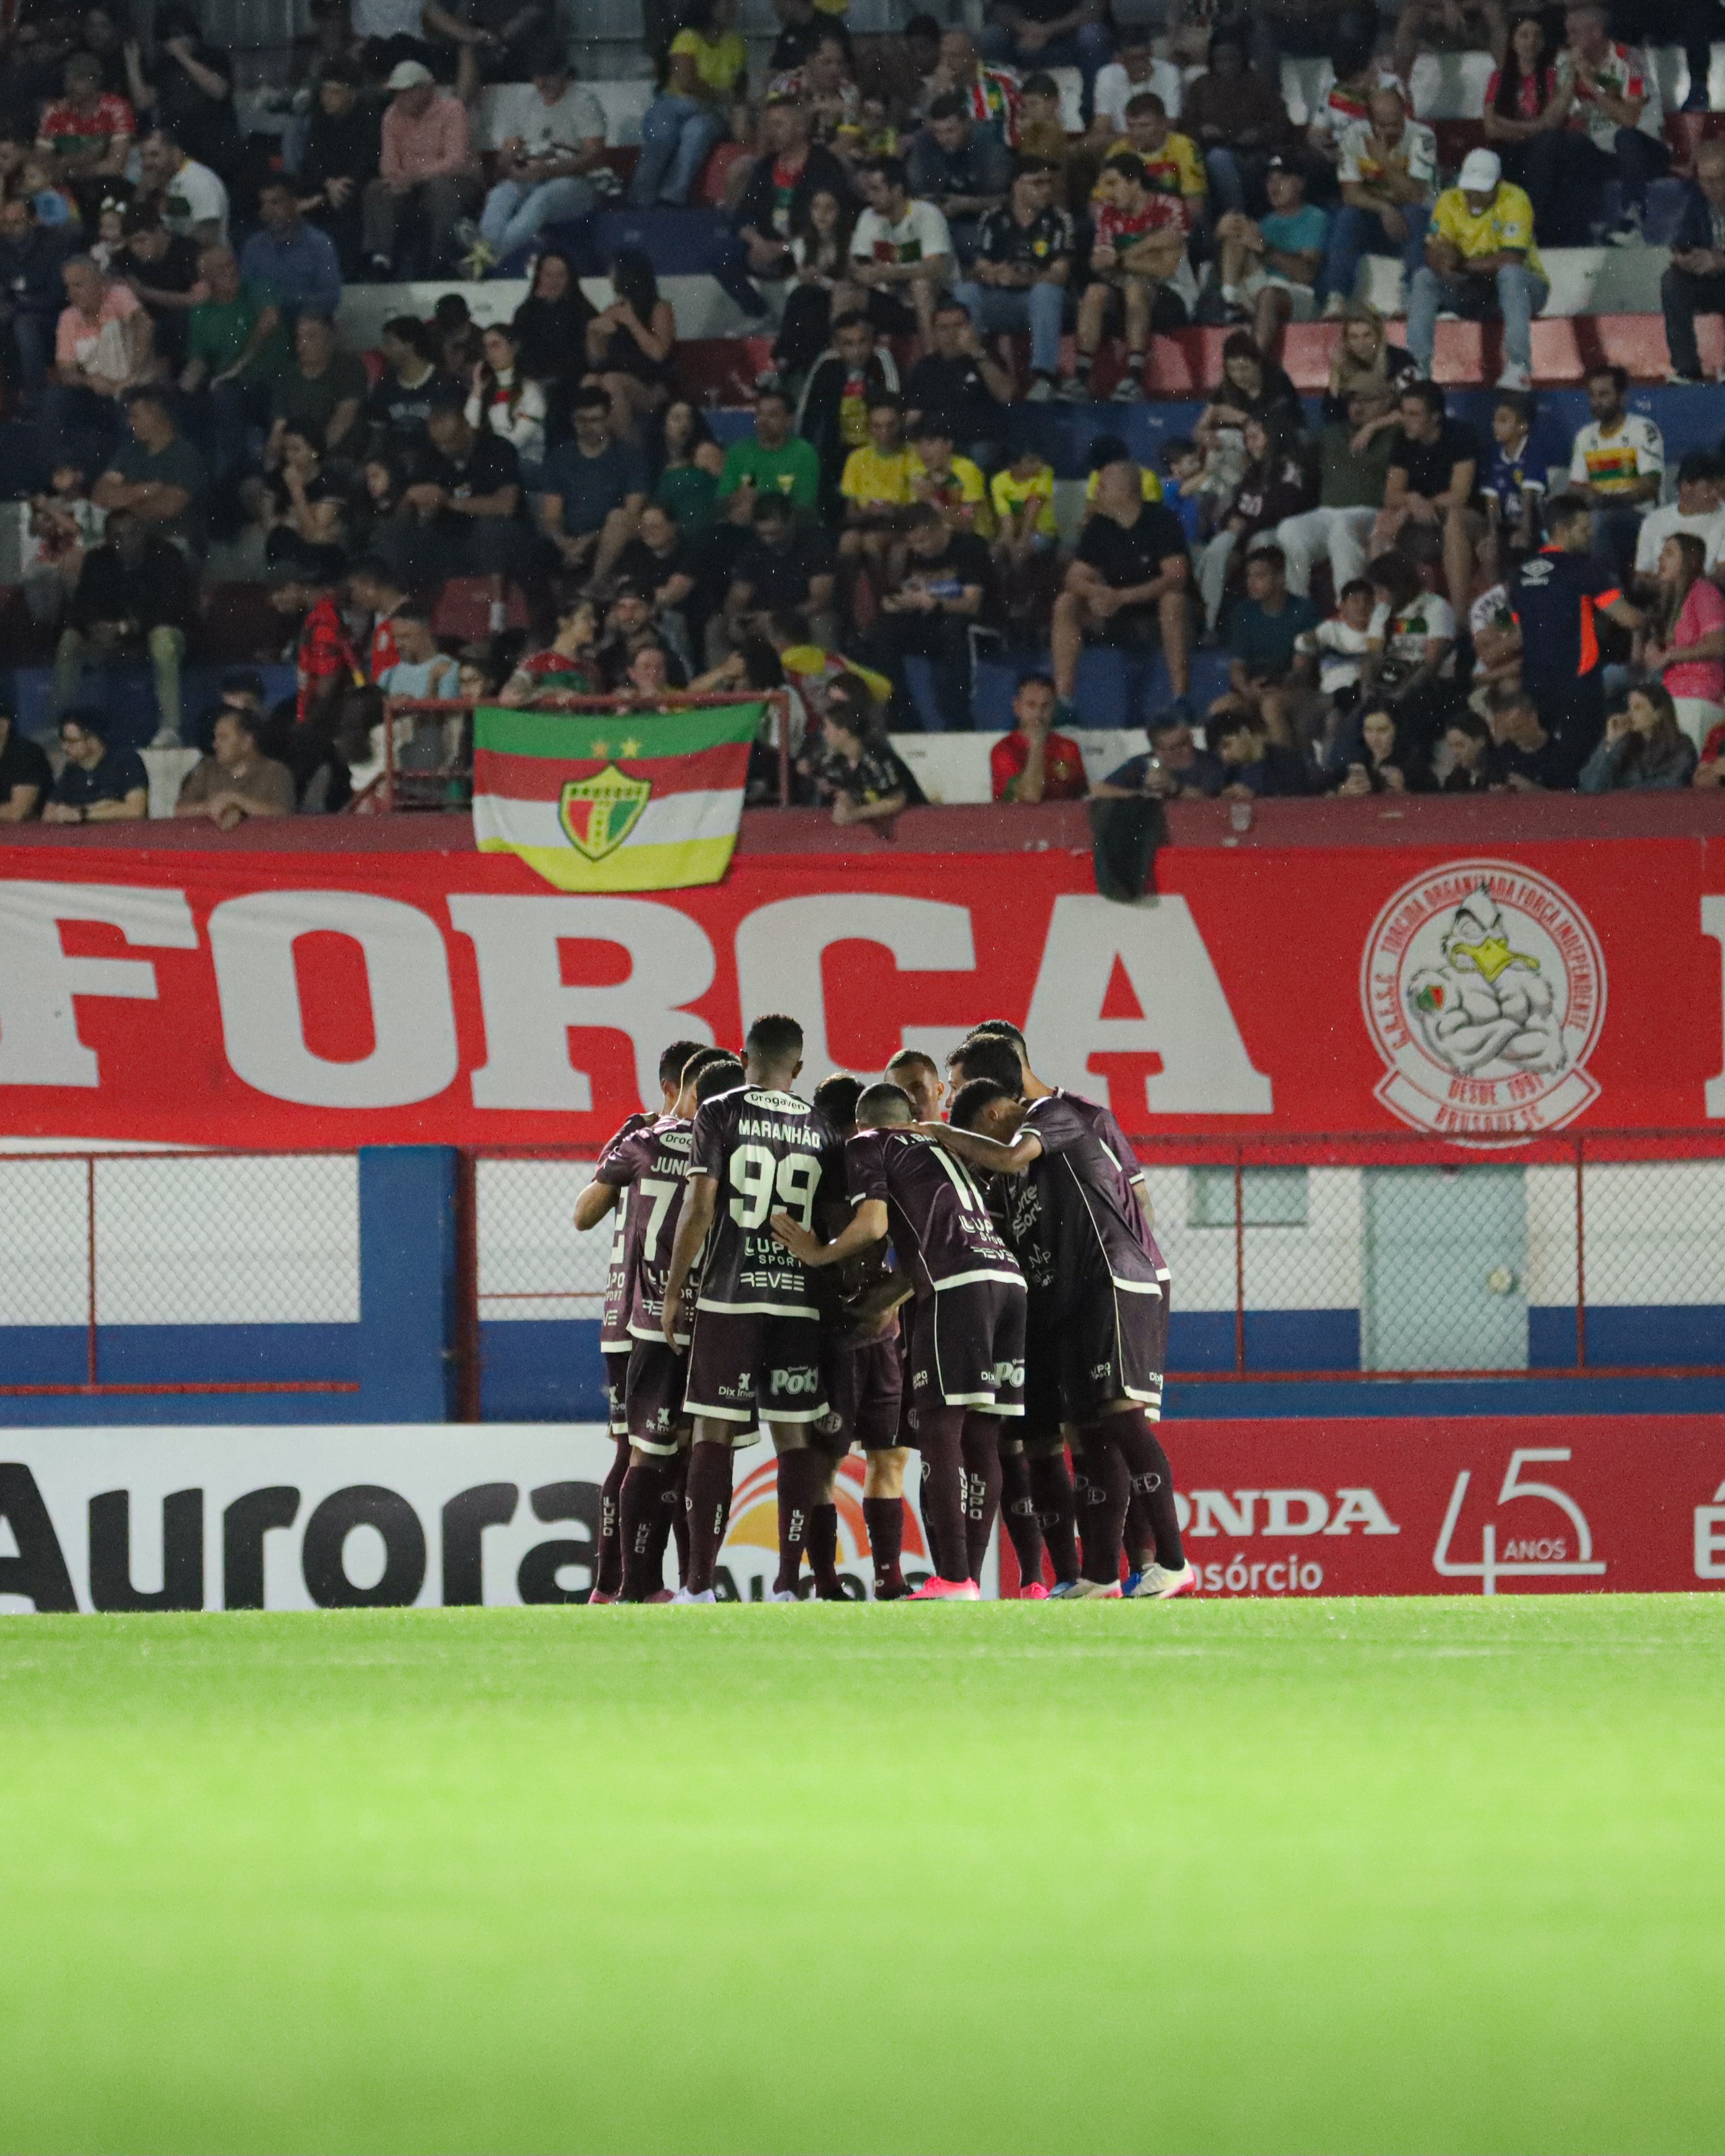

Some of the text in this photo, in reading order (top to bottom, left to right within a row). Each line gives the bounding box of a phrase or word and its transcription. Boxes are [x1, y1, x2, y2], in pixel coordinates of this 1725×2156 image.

[738, 1118, 821, 1149] MARANHÃO
[729, 1144, 823, 1233] 99
[744, 1236, 798, 1257] LUP
[718, 1386, 735, 1397] Dix
[969, 1473, 986, 1521] LUPO
[788, 1509, 805, 1542] LUPO
[1503, 1539, 1567, 1560] ANOS
